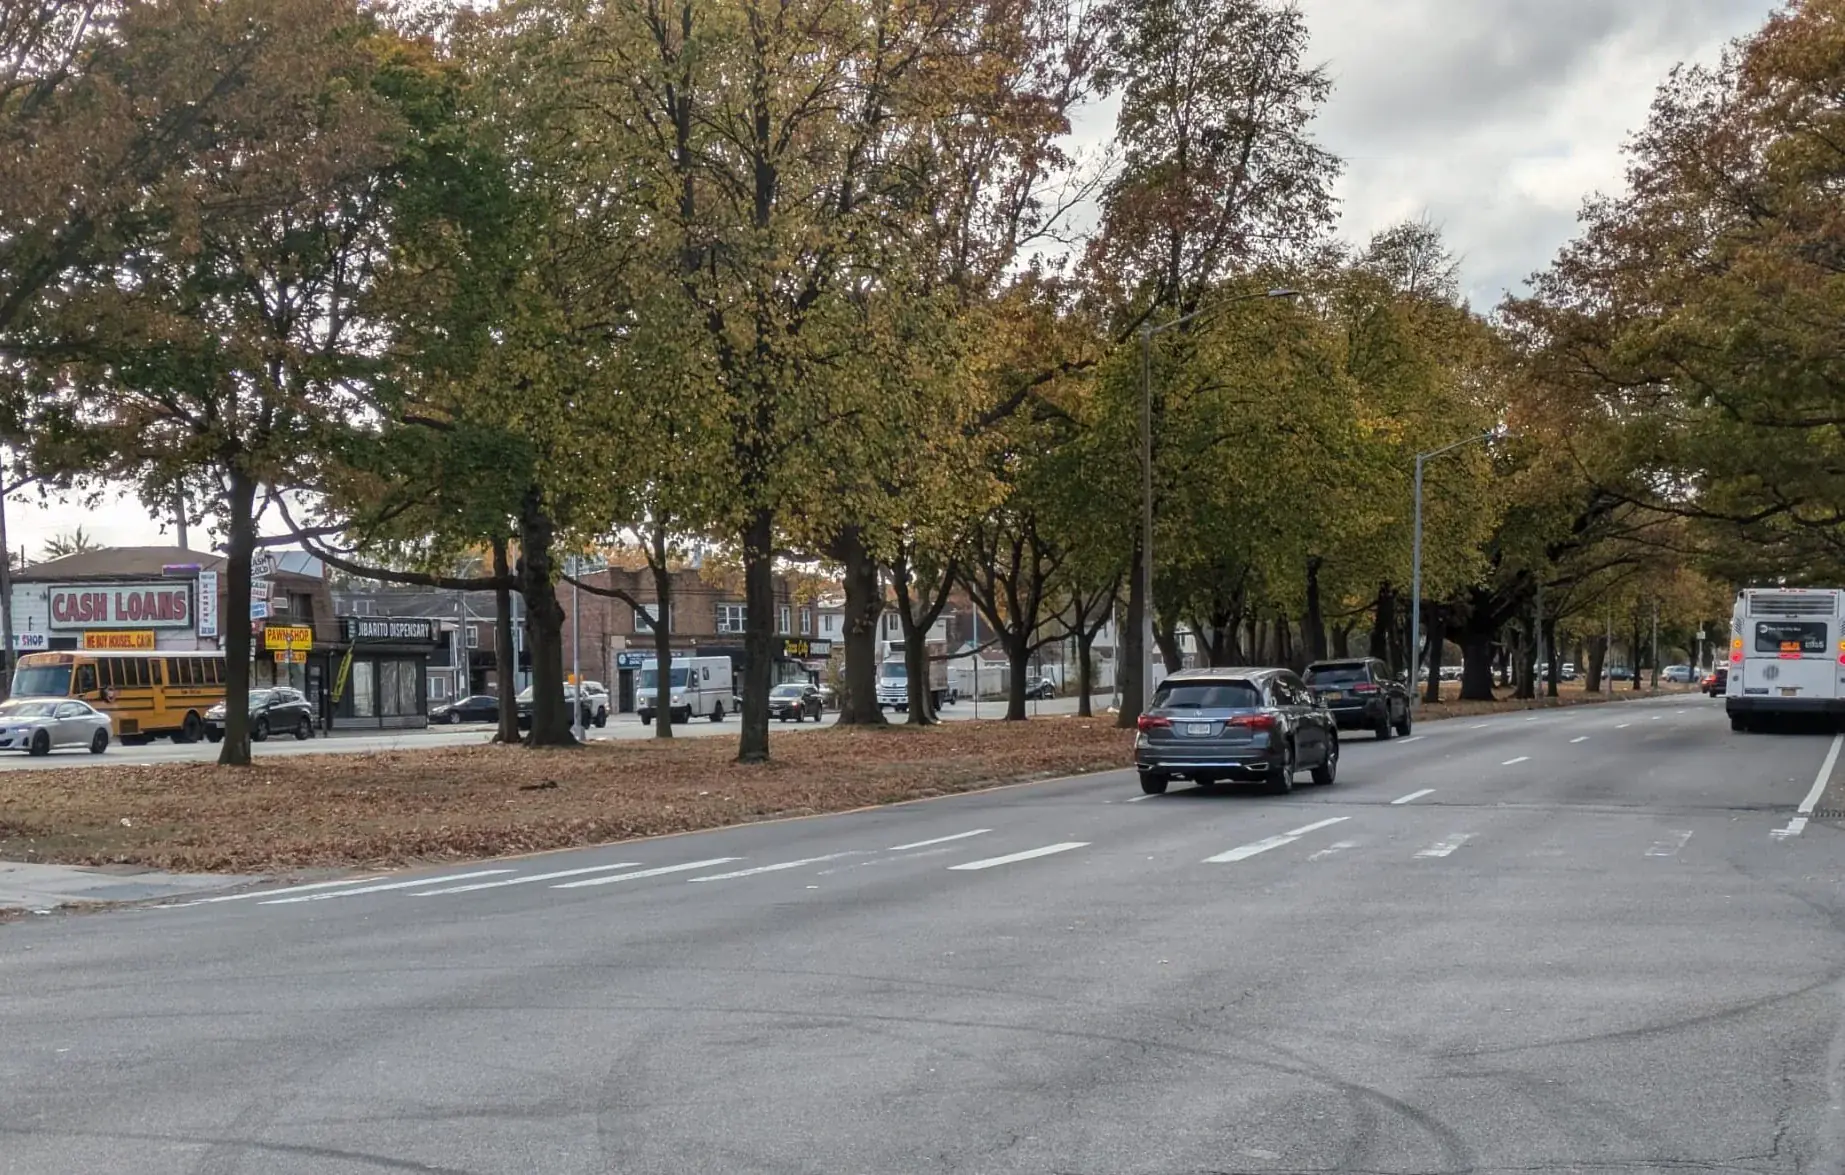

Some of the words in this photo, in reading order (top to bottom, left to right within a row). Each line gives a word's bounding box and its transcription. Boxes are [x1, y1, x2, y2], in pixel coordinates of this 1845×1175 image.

[52, 593, 108, 622] CASH
[114, 591, 187, 621] LOANS
[267, 629, 287, 641] PAWN
[290, 629, 309, 642] SHOP
[358, 622, 388, 637] JIBARITO
[389, 623, 430, 637] DISPENSARY
[21, 635, 44, 646] SHOP
